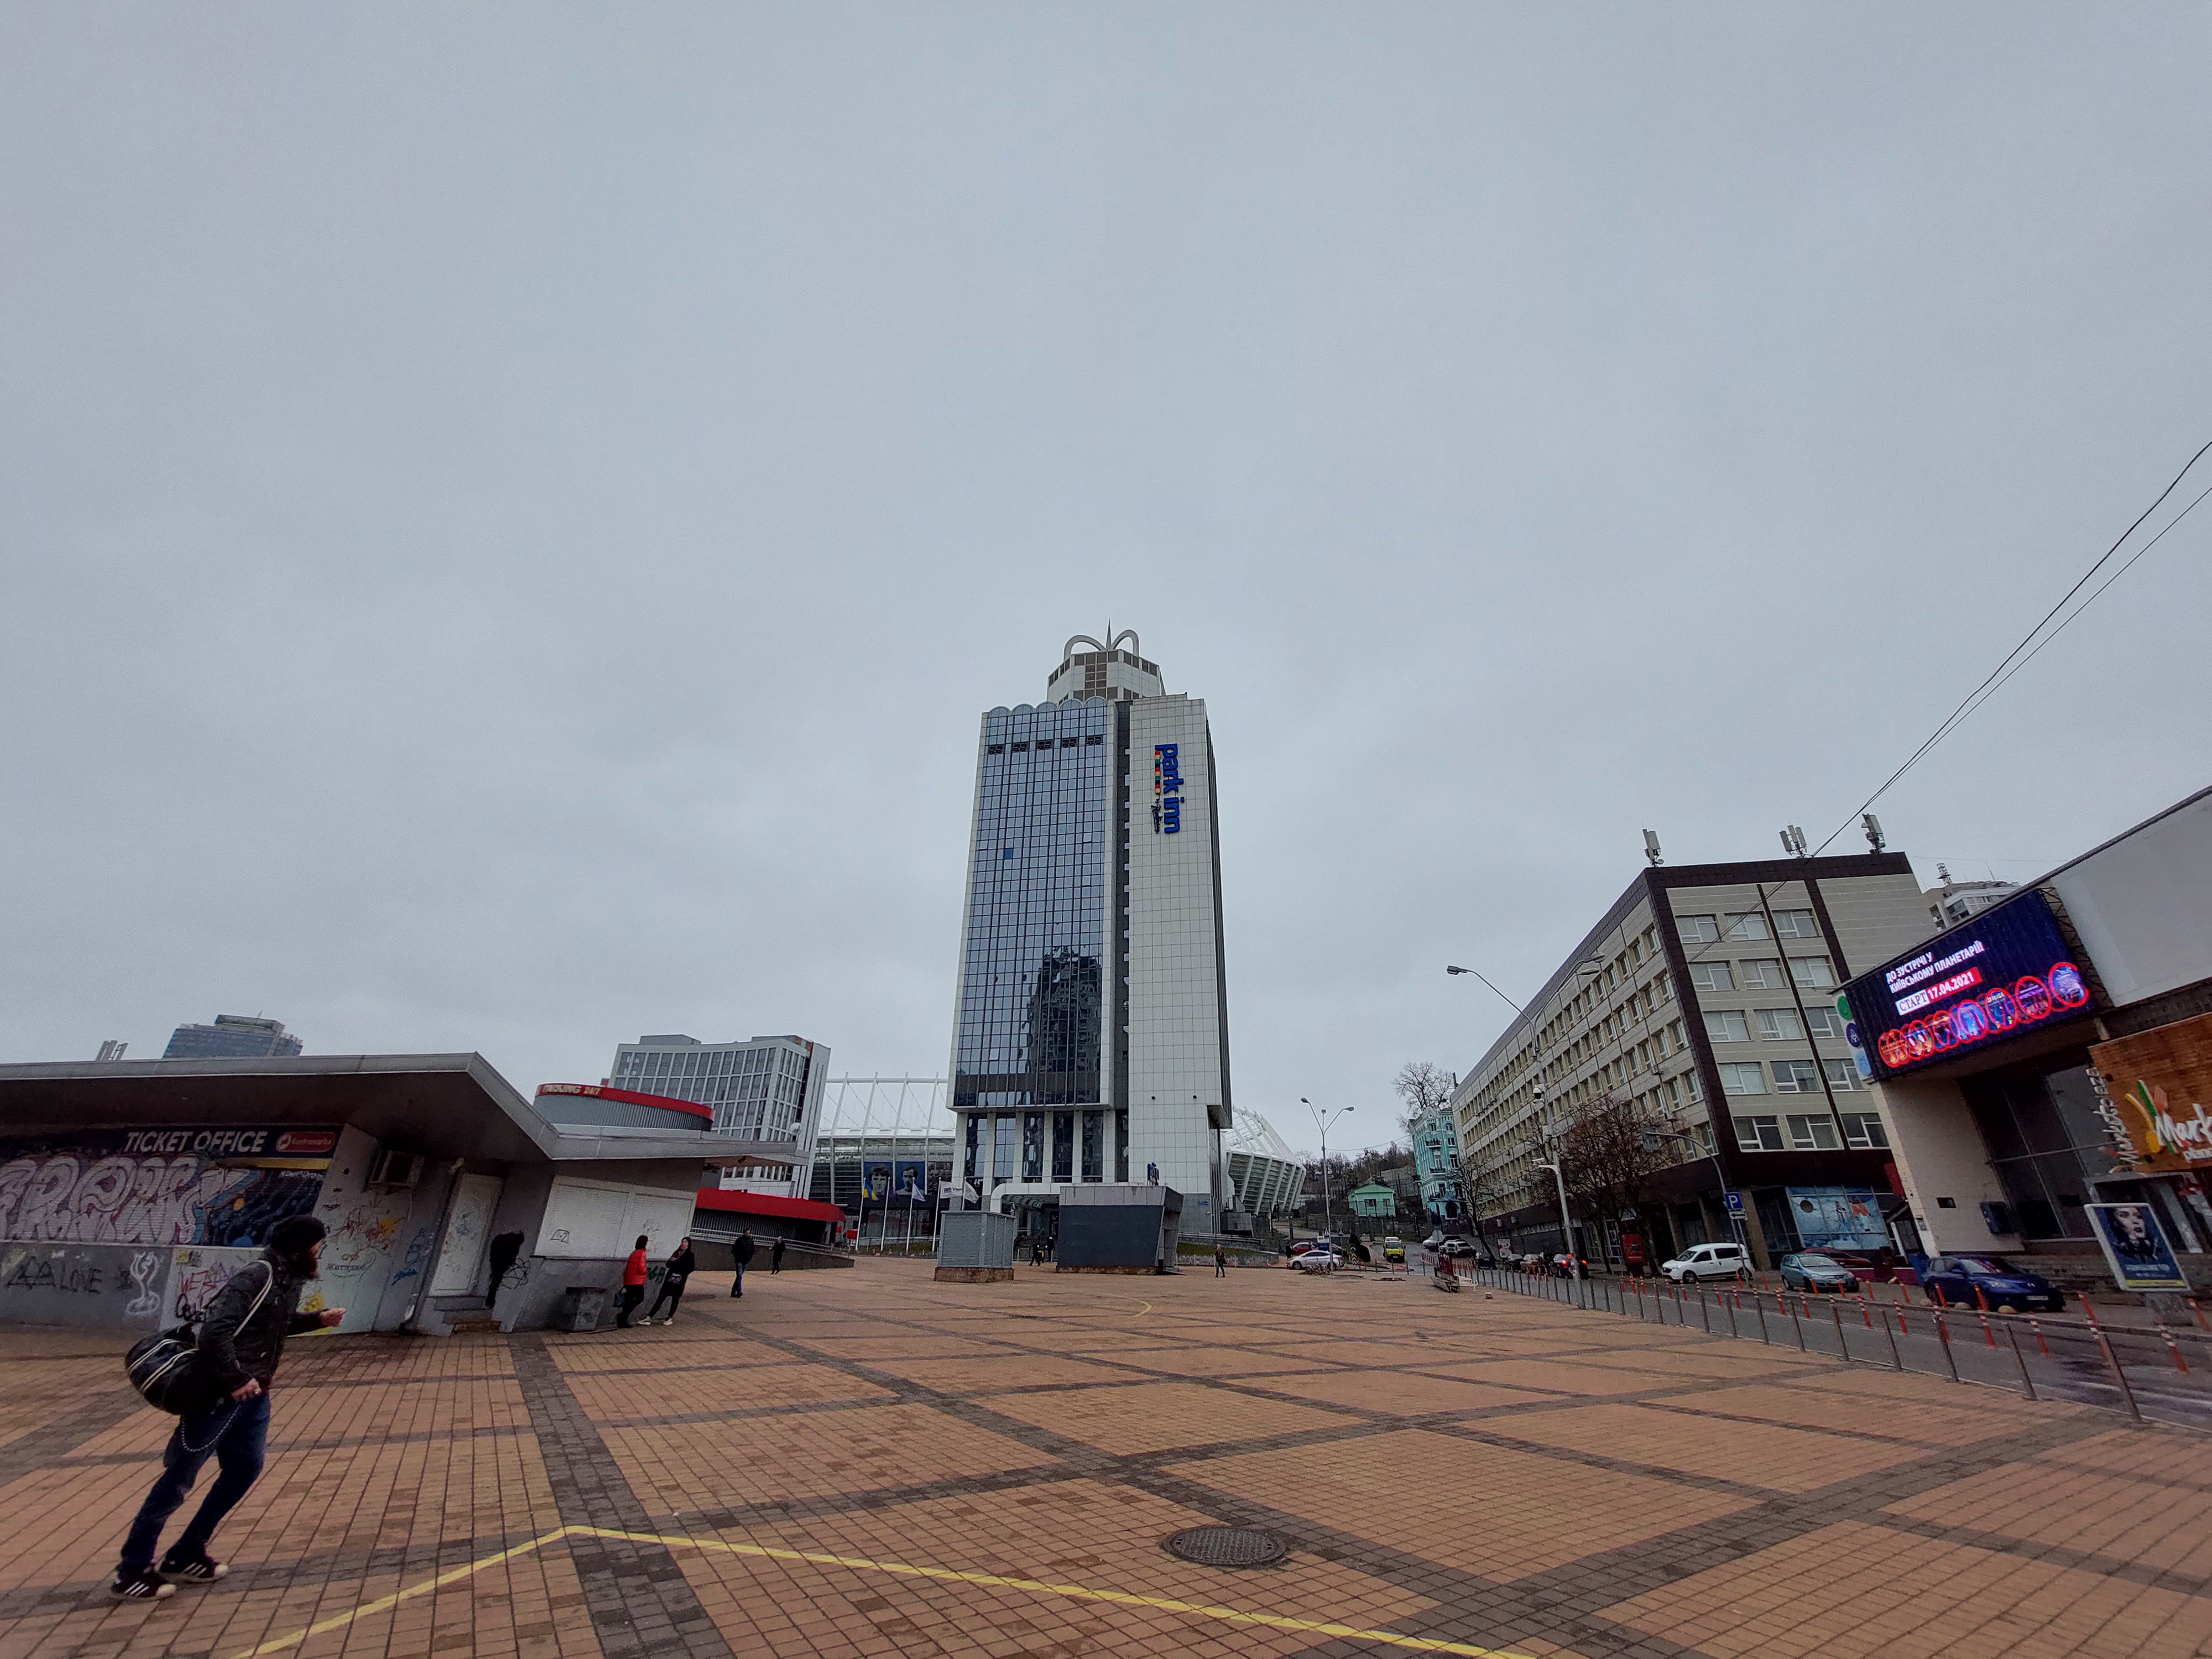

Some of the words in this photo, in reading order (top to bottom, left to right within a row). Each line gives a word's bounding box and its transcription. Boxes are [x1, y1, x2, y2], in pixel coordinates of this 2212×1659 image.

[1155, 743, 1184, 794] park
[1164, 796, 1185, 833] inn
[1886, 971, 1897, 984] ДО
[1895, 954, 1928, 977] ЗУСТРІЧІ
[1926, 952, 1933, 962] У
[1889, 965, 1934, 993] КИЇВСЬКОМУ
[1934, 940, 1985, 972] ПЛАНЕТАРІЇ!
[1899, 992, 1928, 1011] СТАРТ
[1927, 972, 1975, 999] 17.04.2021
[542, 1084, 582, 1093] PARKING
[583, 1087, 602, 1095] 24/7
[124, 1131, 194, 1152] TICKET
[194, 1131, 268, 1152] OFFICE
[1728, 1195, 1738, 1208] P
